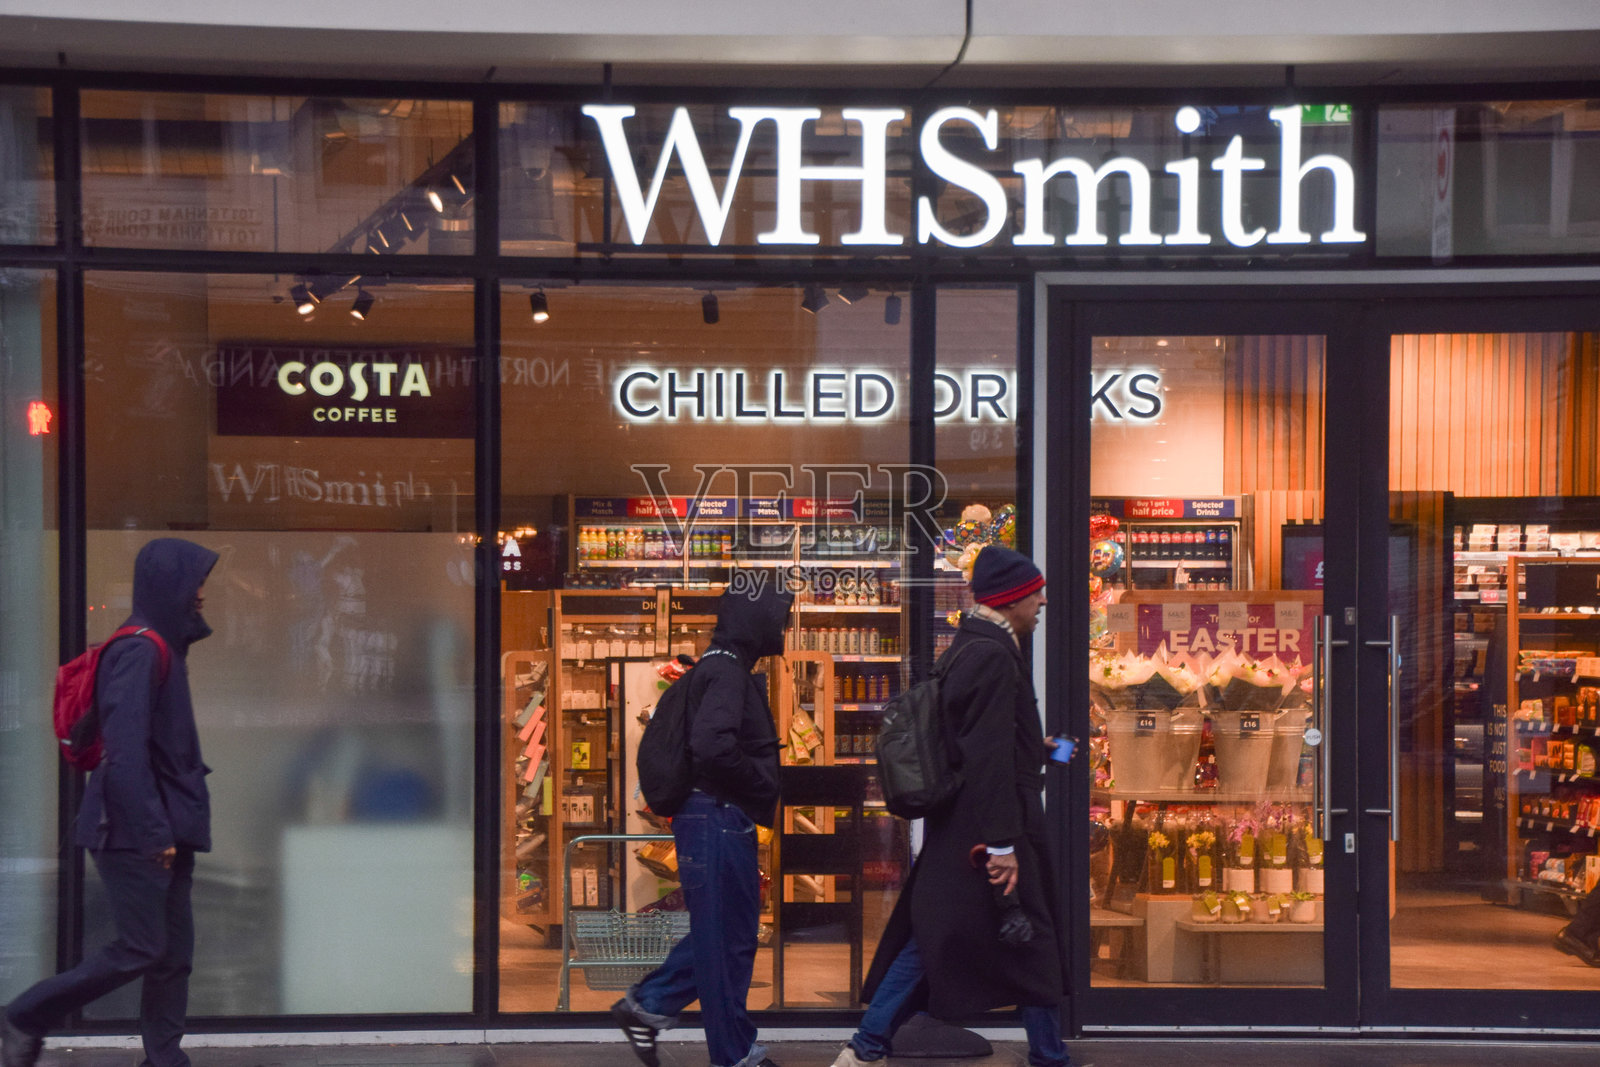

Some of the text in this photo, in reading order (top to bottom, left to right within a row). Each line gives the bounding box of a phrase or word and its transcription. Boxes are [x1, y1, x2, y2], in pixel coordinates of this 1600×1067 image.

[581, 104, 1367, 249] WHSmith
[278, 361, 431, 401] COSTA
[618, 371, 896, 420] CHILLED
[934, 373, 1162, 419] DRKS
[313, 407, 397, 424] COFFEE
[635, 506, 653, 514] half
[696, 500, 727, 508] Selected
[802, 507, 818, 515] half
[1132, 507, 1174, 517] half price
[642, 601, 684, 610] DIAL
[1169, 628, 1300, 652] EASTER
[1493, 704, 1507, 718] THIS
[1140, 718, 1153, 727] £16
[1243, 719, 1256, 728] £16
[1494, 723, 1507, 736] NOT
[1492, 742, 1507, 755] JUST
[1489, 760, 1506, 773] FOOD
